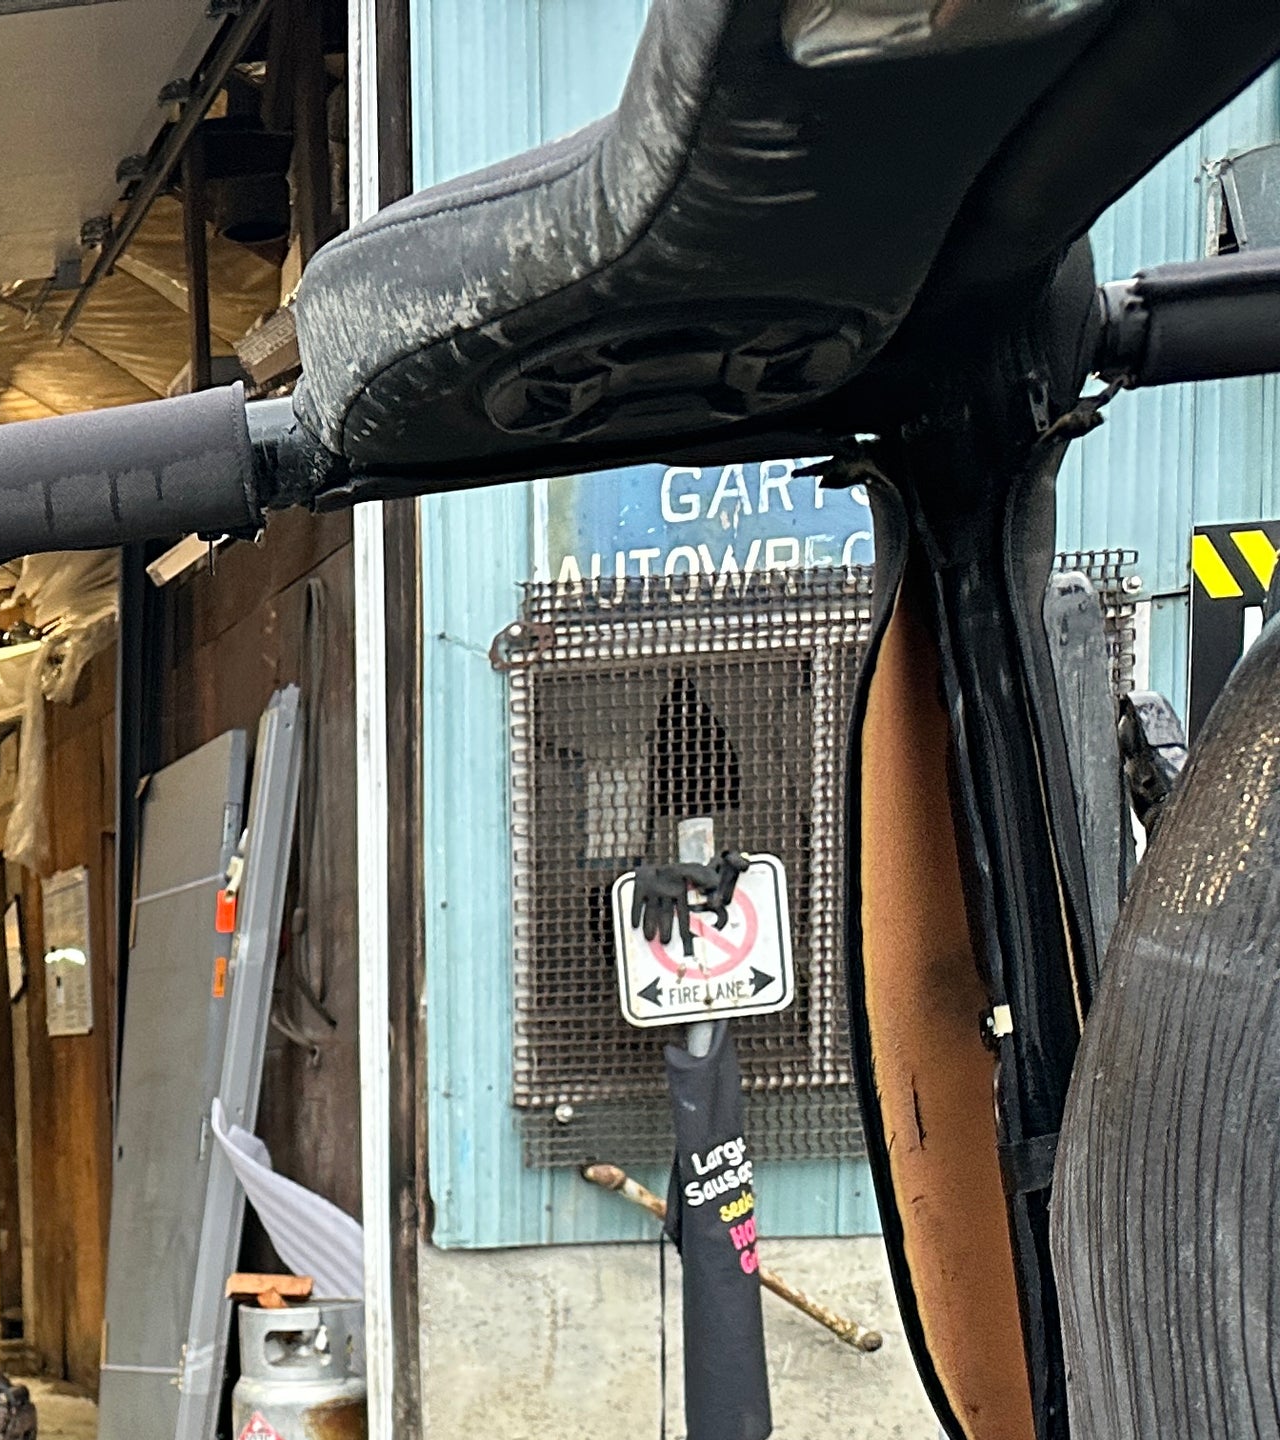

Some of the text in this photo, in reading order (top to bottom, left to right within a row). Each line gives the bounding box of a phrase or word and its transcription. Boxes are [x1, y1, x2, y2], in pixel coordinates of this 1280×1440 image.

[661, 456, 870, 522] GAR
[669, 980, 748, 1006] FIRE LANE
